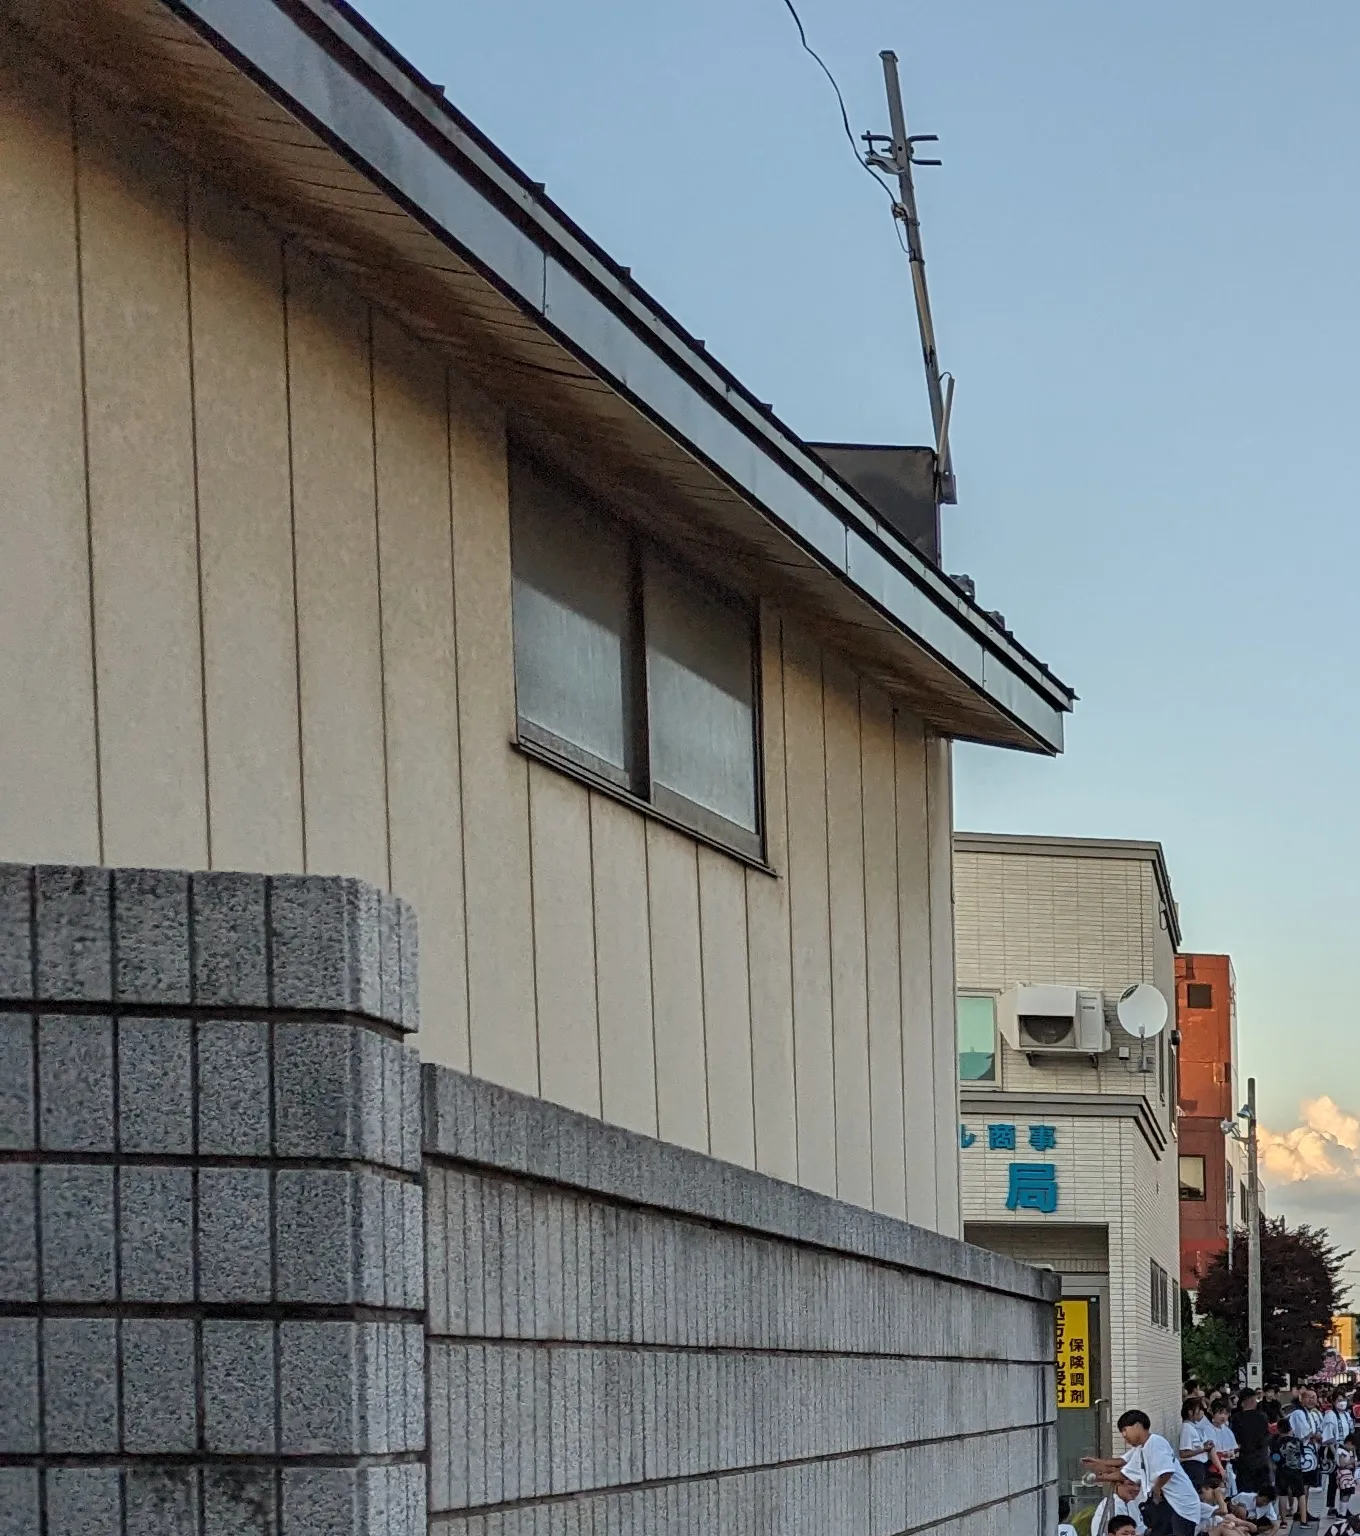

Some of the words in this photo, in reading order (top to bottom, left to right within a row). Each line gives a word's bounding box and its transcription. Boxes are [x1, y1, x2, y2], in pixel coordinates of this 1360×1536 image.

[1004, 1162, 1059, 1213] 局
[1069, 1338, 1085, 1404] 保険調剤
